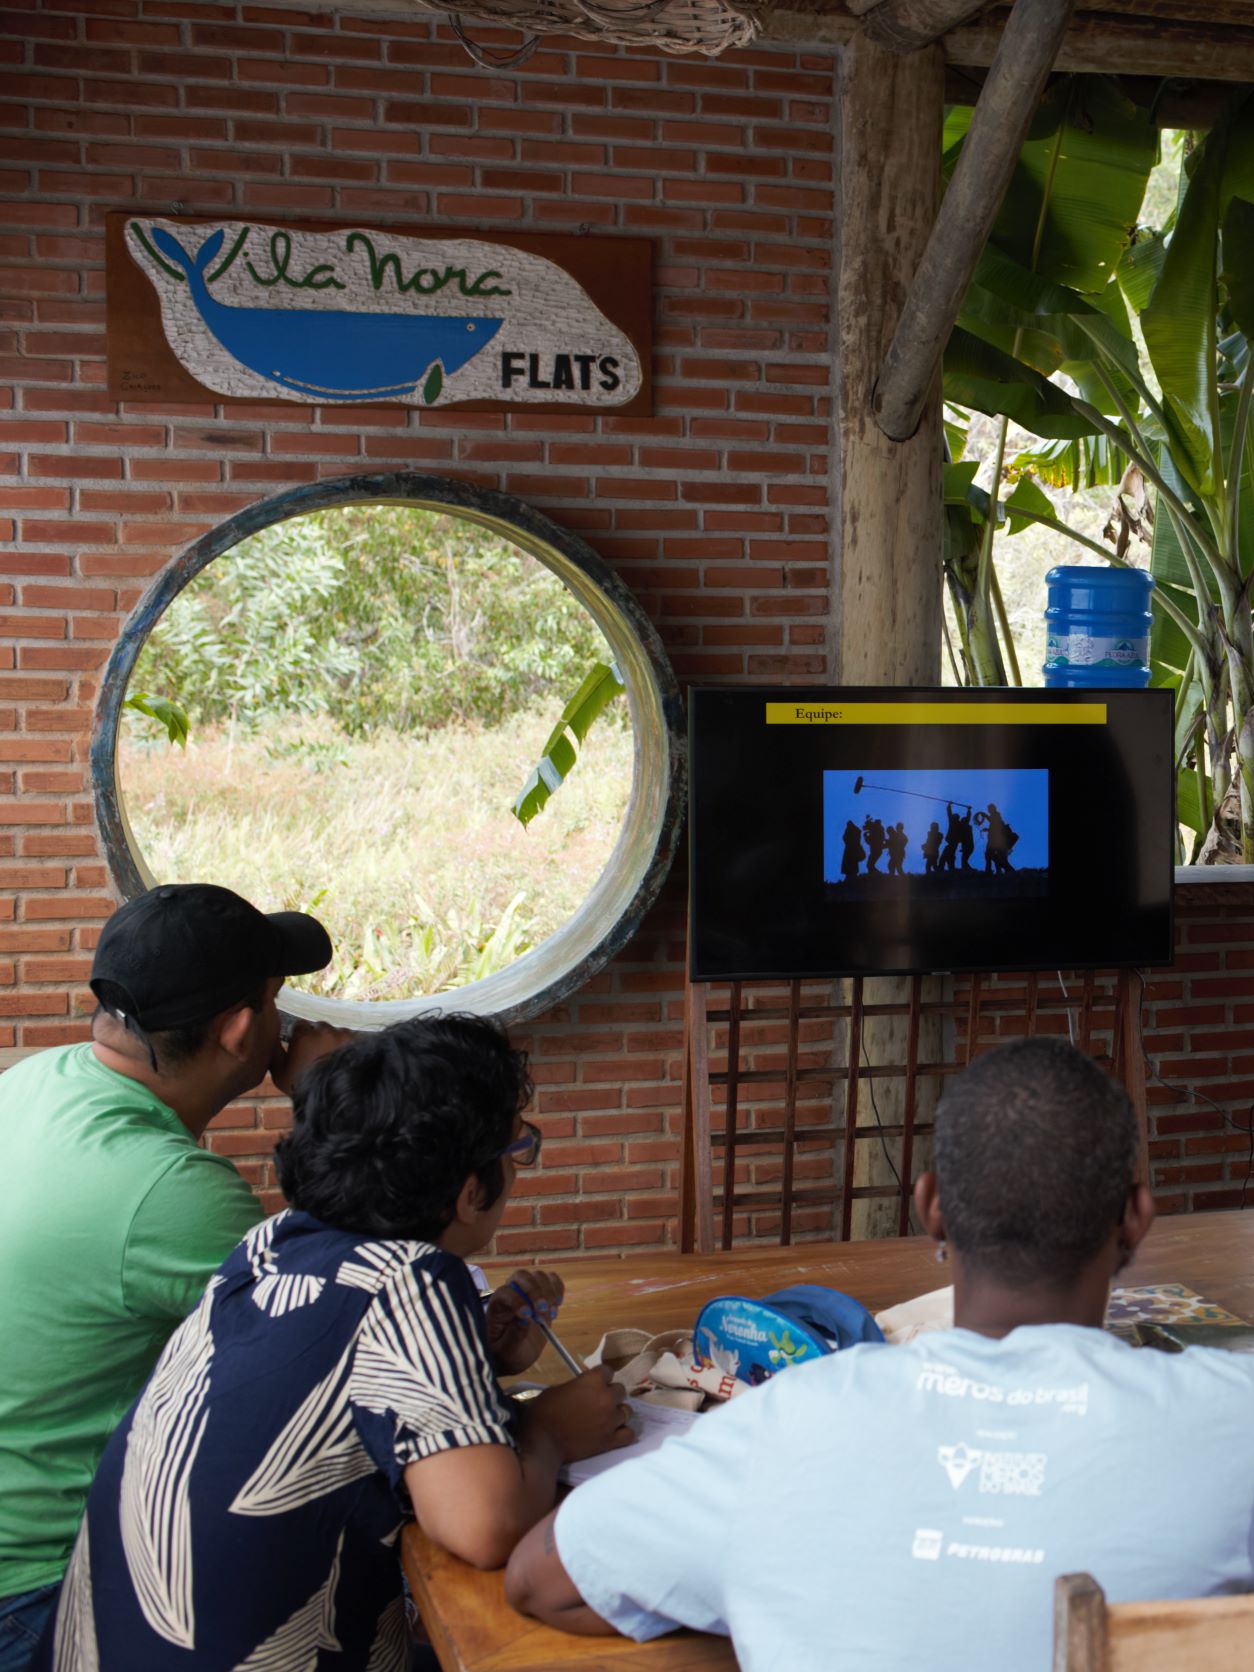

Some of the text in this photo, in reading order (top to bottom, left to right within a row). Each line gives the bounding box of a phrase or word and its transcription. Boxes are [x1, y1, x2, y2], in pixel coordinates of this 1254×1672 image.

[130, 222, 346, 290] Vila
[502, 352, 620, 391] FLATS
[795, 708, 843, 722] Equipe:
[917, 1371, 1004, 1403] meros
